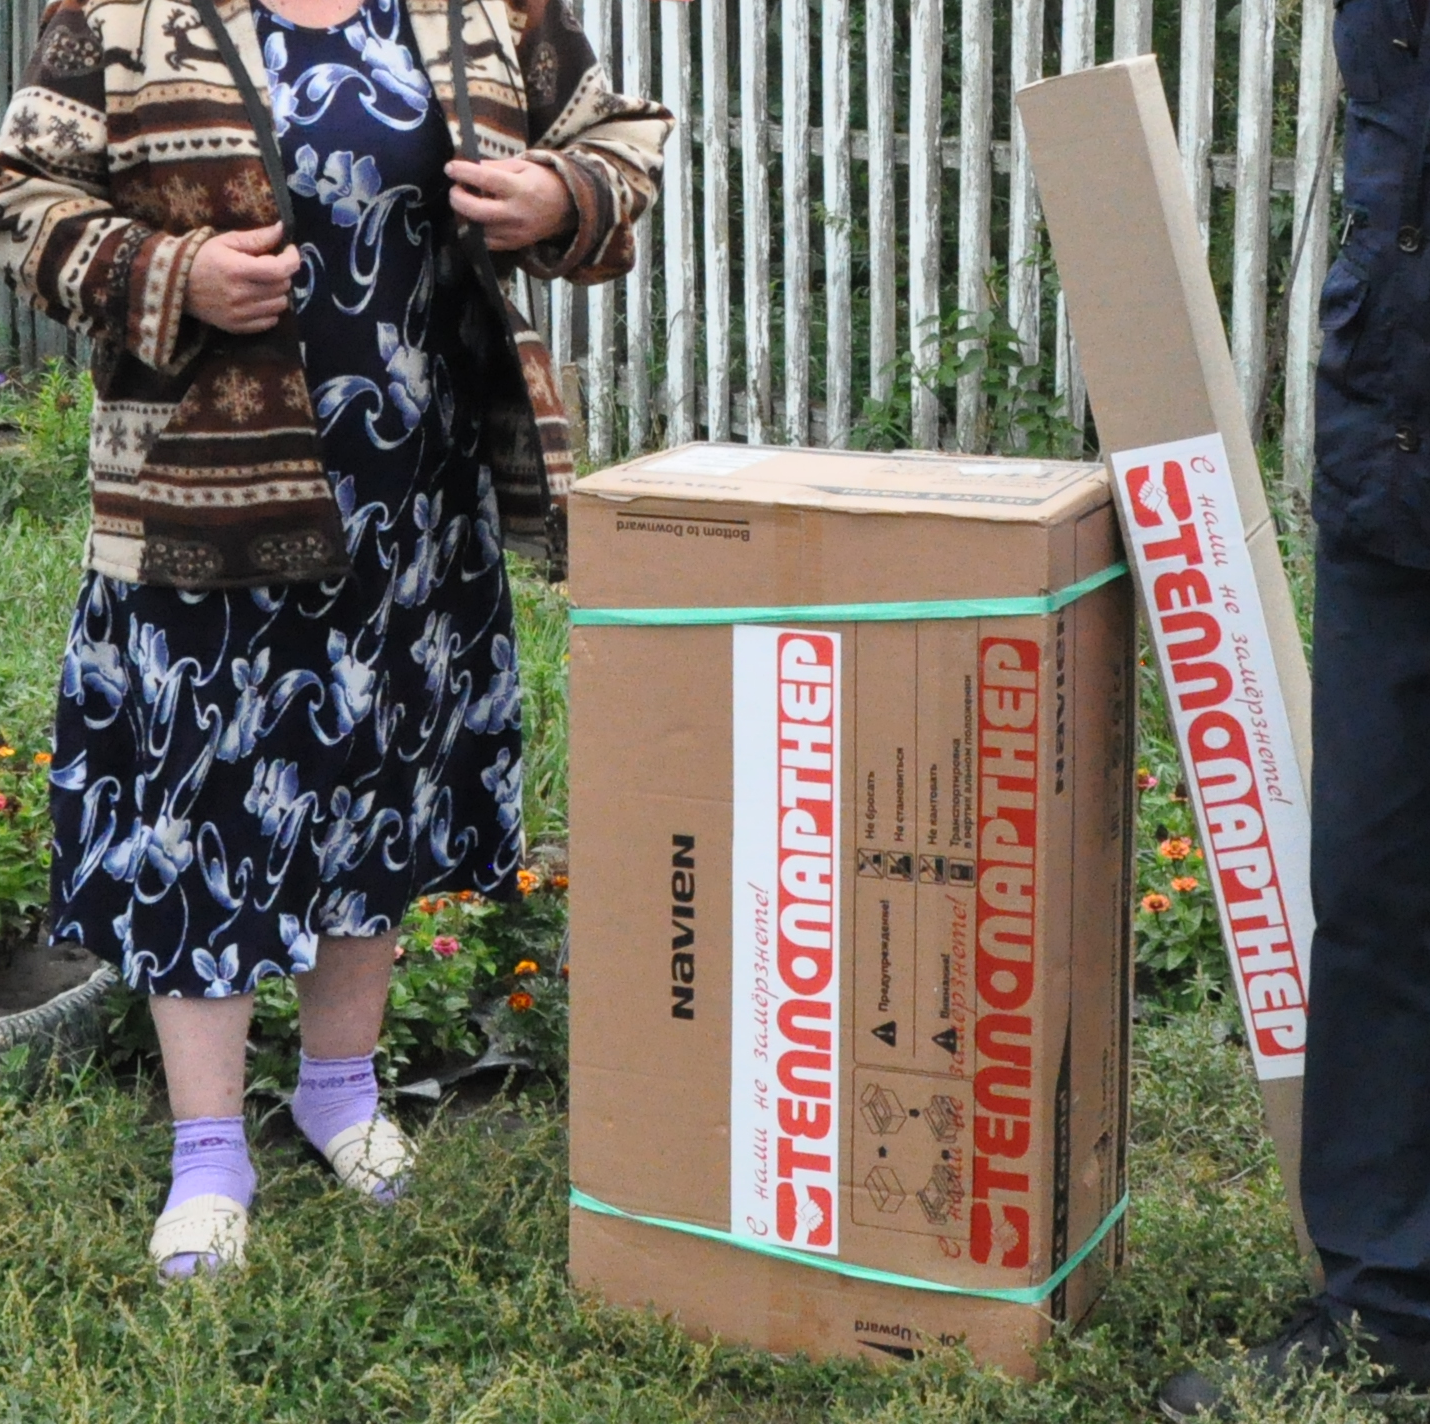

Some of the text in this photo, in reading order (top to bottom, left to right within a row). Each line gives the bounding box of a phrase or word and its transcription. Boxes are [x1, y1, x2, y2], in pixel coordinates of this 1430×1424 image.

[616, 520, 750, 541] Bottom to Downward
[1189, 455, 1293, 806] С нами не замёрзнете!
[865, 770, 875, 839] Не бросать
[894, 747, 904, 842] Не становиться
[928, 763, 937, 845] Не кантовать
[949, 738, 961, 847] Транспортировка
[878, 900, 891, 1012] Предупреждение!
[940, 953, 950, 1019] Внимание!
[746, 881, 779, 1237] С нами не замёрзнете!
[854, 1319, 912, 1342] Upward
